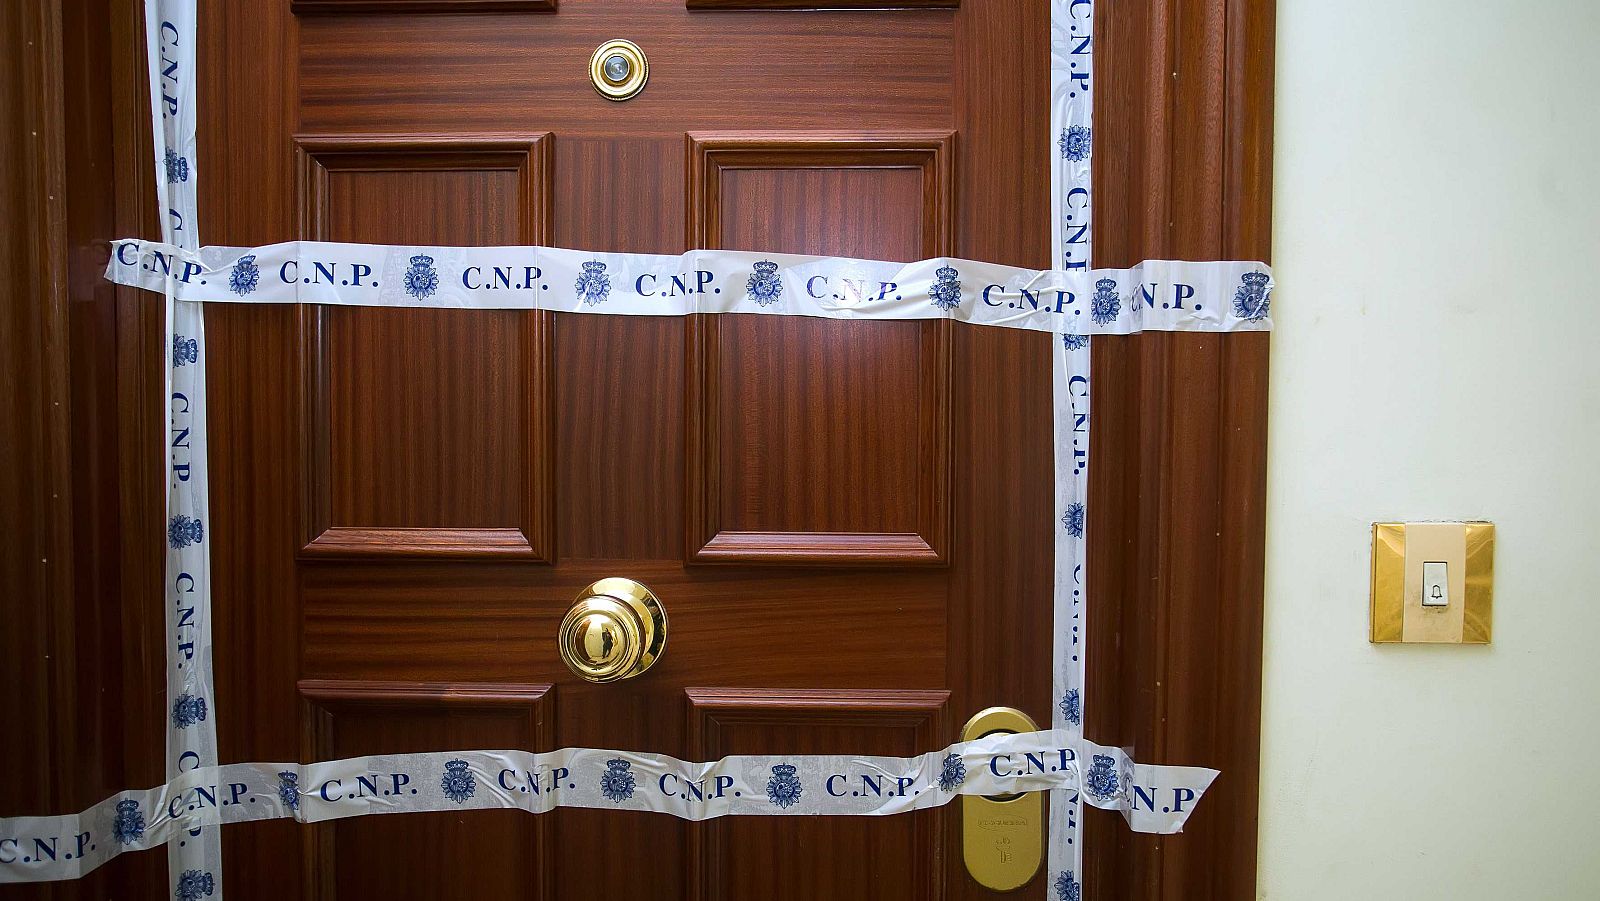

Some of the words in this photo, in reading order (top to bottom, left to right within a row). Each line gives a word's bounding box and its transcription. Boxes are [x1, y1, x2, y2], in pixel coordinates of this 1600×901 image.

[159, 21, 179, 119] C.N.P.
[117, 242, 207, 285] C.N.P.
[279, 259, 380, 288] C.N.P.
[462, 265, 549, 292] C.N.P.
[635, 269, 722, 298] C.N.P.
[806, 273, 903, 304] C.N.P.
[981, 282, 1081, 317] C.N.P.
[170, 391, 190, 489] C.N.P.
[175, 572, 195, 669] C.N.P.
[0, 830, 96, 866] C.N.P.
[168, 782, 256, 820] C.N.P.
[320, 772, 418, 802] C.N.P.
[498, 766, 577, 796] C.N.P.
[659, 767, 742, 803] C.N.P.
[825, 773, 921, 798] C.N.P.
